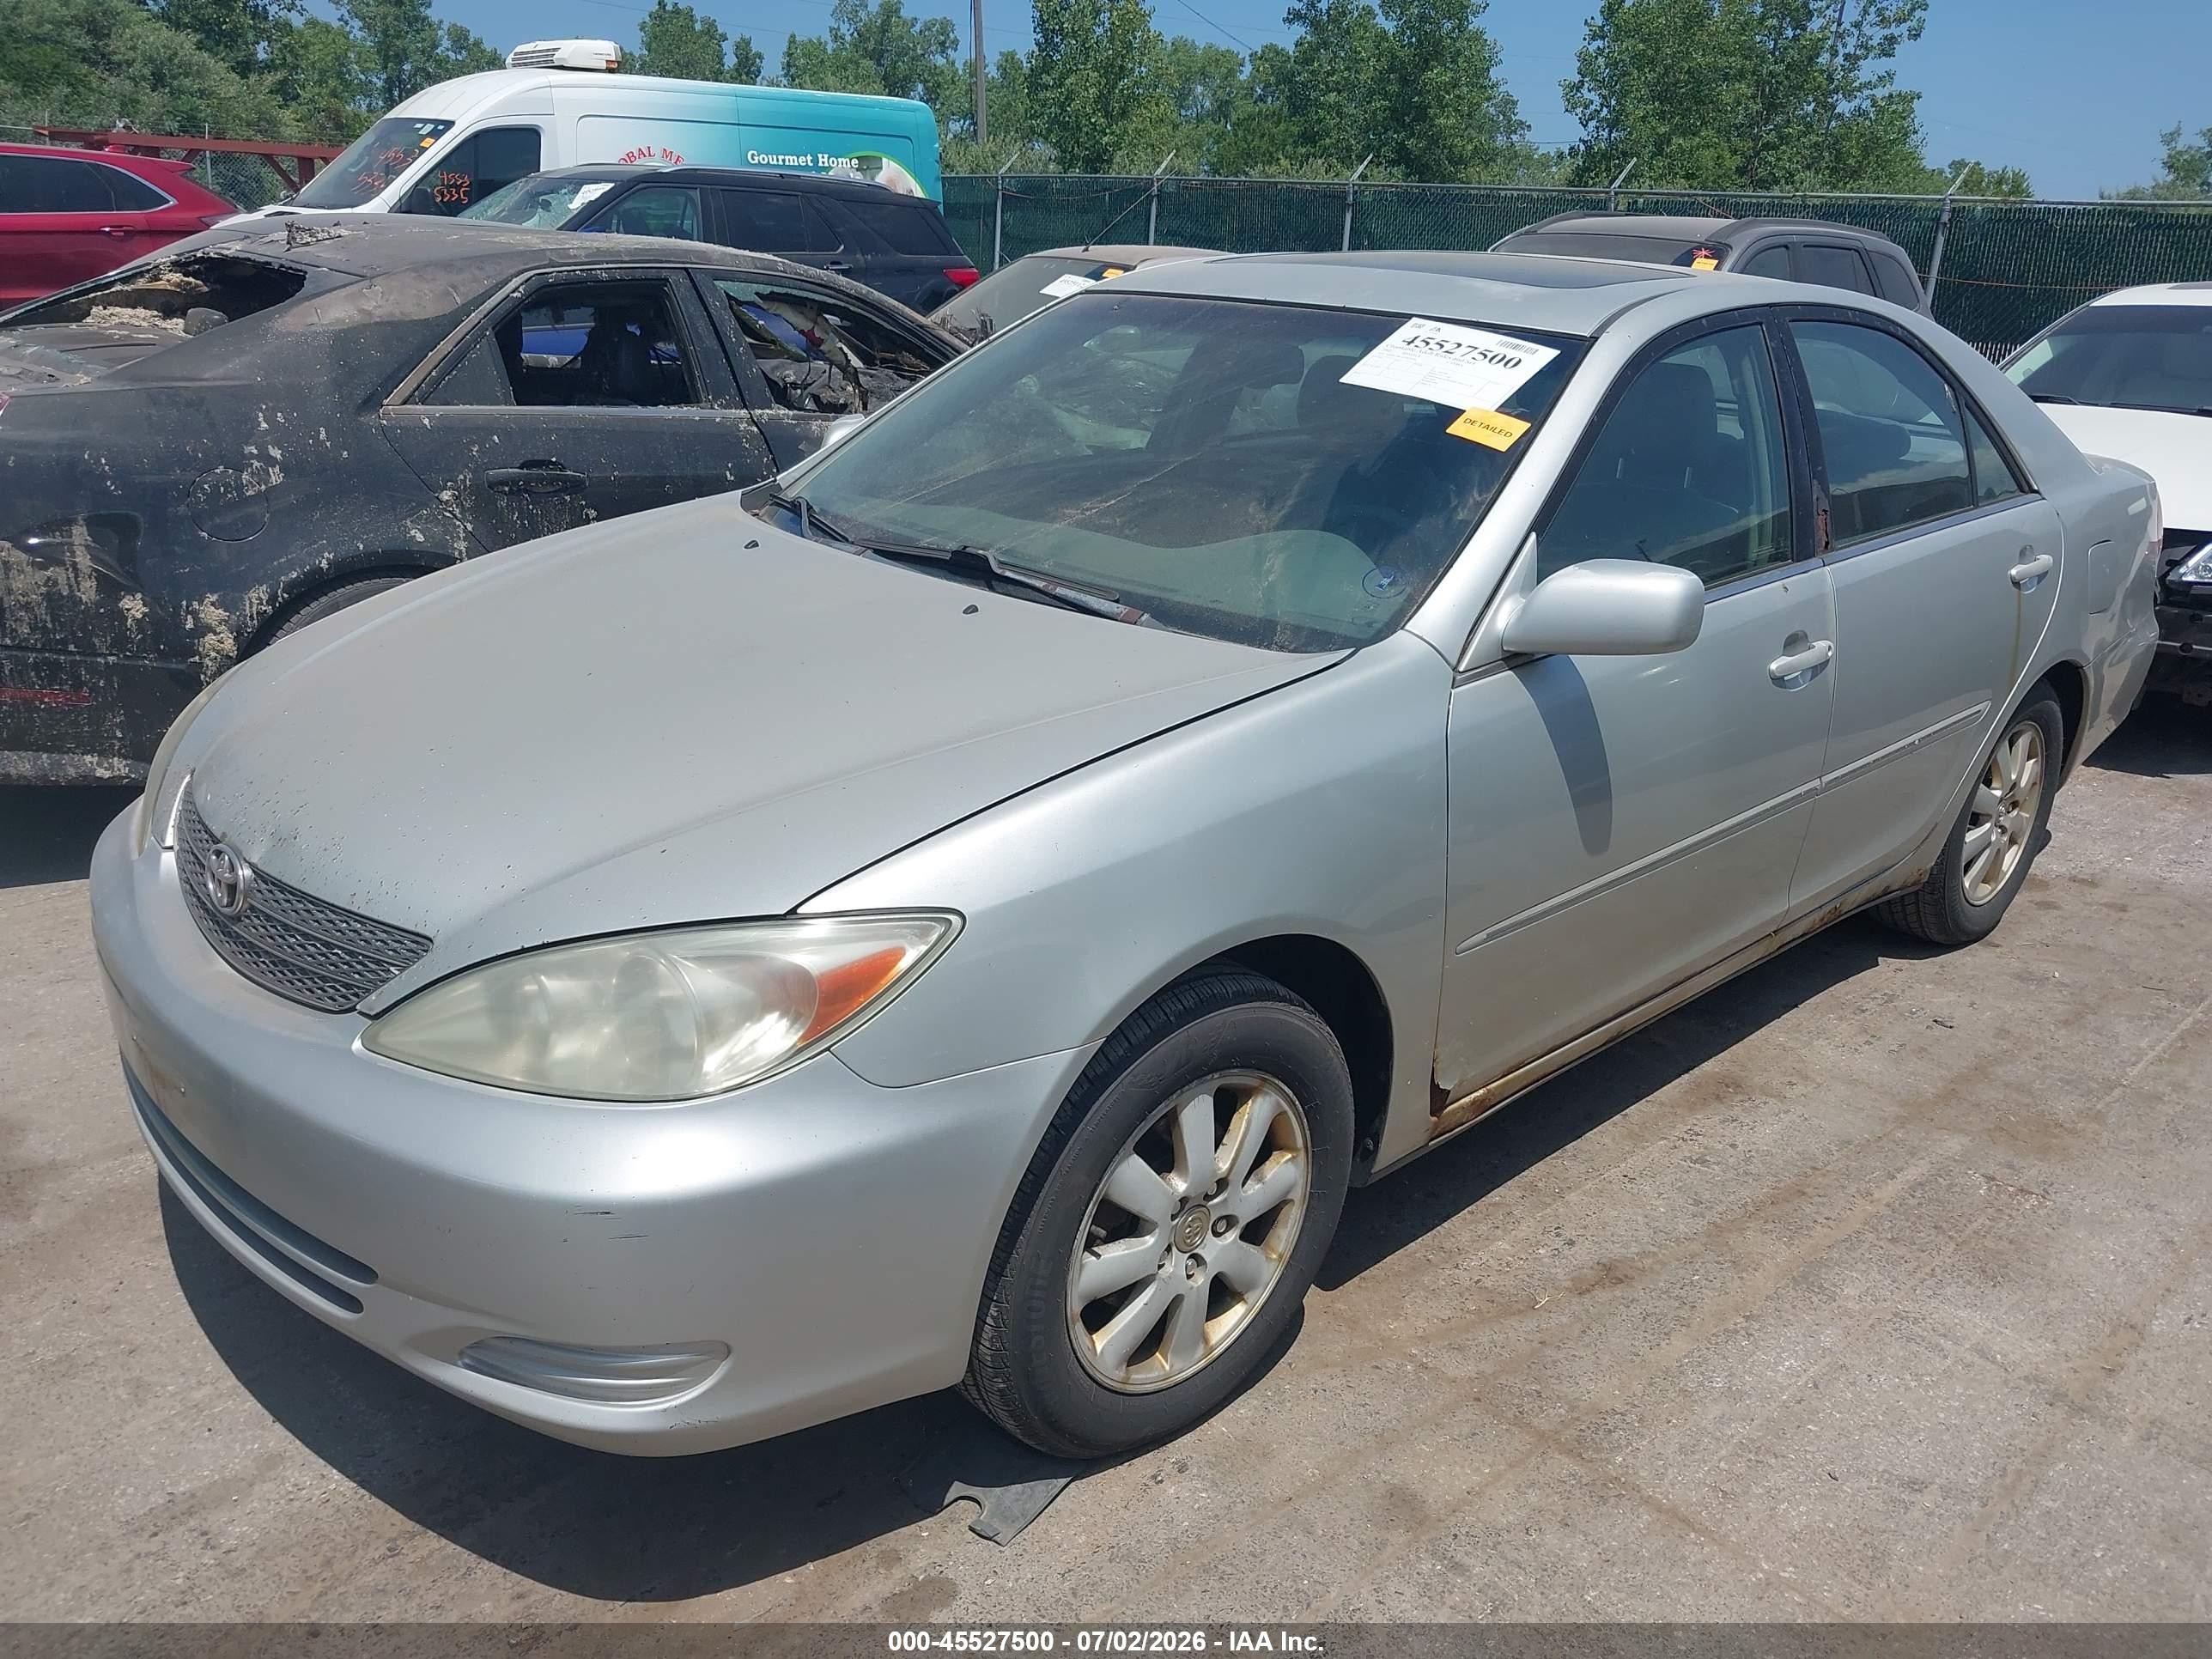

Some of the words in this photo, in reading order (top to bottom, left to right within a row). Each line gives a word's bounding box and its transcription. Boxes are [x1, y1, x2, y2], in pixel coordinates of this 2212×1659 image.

[747, 150, 813, 167] Gourmet
[817, 153, 860, 168] Home
[434, 185, 471, 204] 5335
[1401, 334, 1522, 369] 45527500
[1463, 417, 1513, 438] DETAILED
